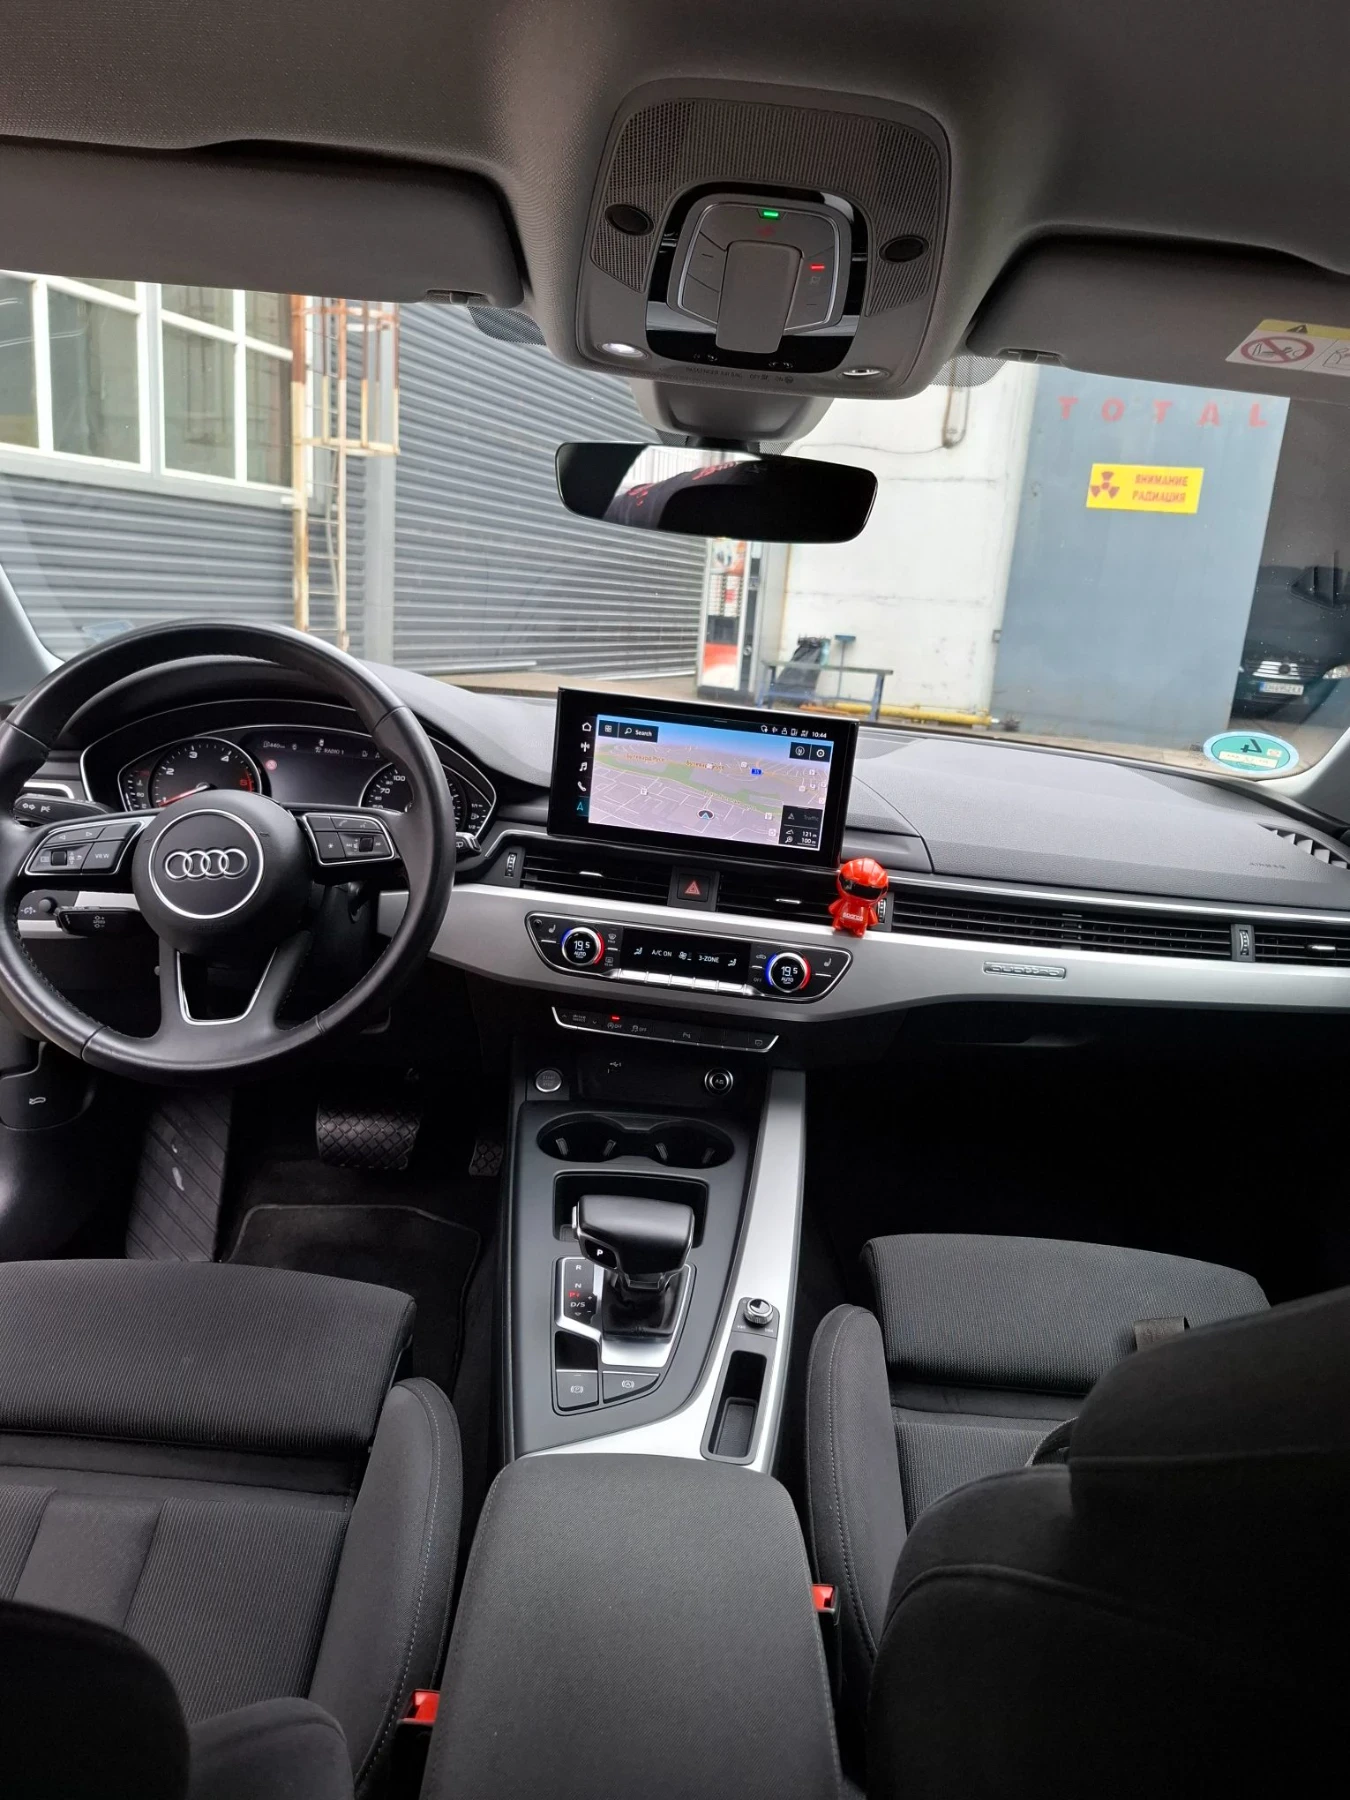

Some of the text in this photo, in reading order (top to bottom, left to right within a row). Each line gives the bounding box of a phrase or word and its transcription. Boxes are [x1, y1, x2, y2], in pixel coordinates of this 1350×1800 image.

[1058, 397, 1268, 427] TOTAL
[1134, 474, 1189, 487] ВНИМАНИЕ
[1132, 490, 1187, 503] РАДИАЦИЯ
[635, 729, 653, 737] Search
[812, 731, 827, 739] 10:44
[189, 751, 198, 759] 3
[698, 955, 720, 964] 3-ZONE
